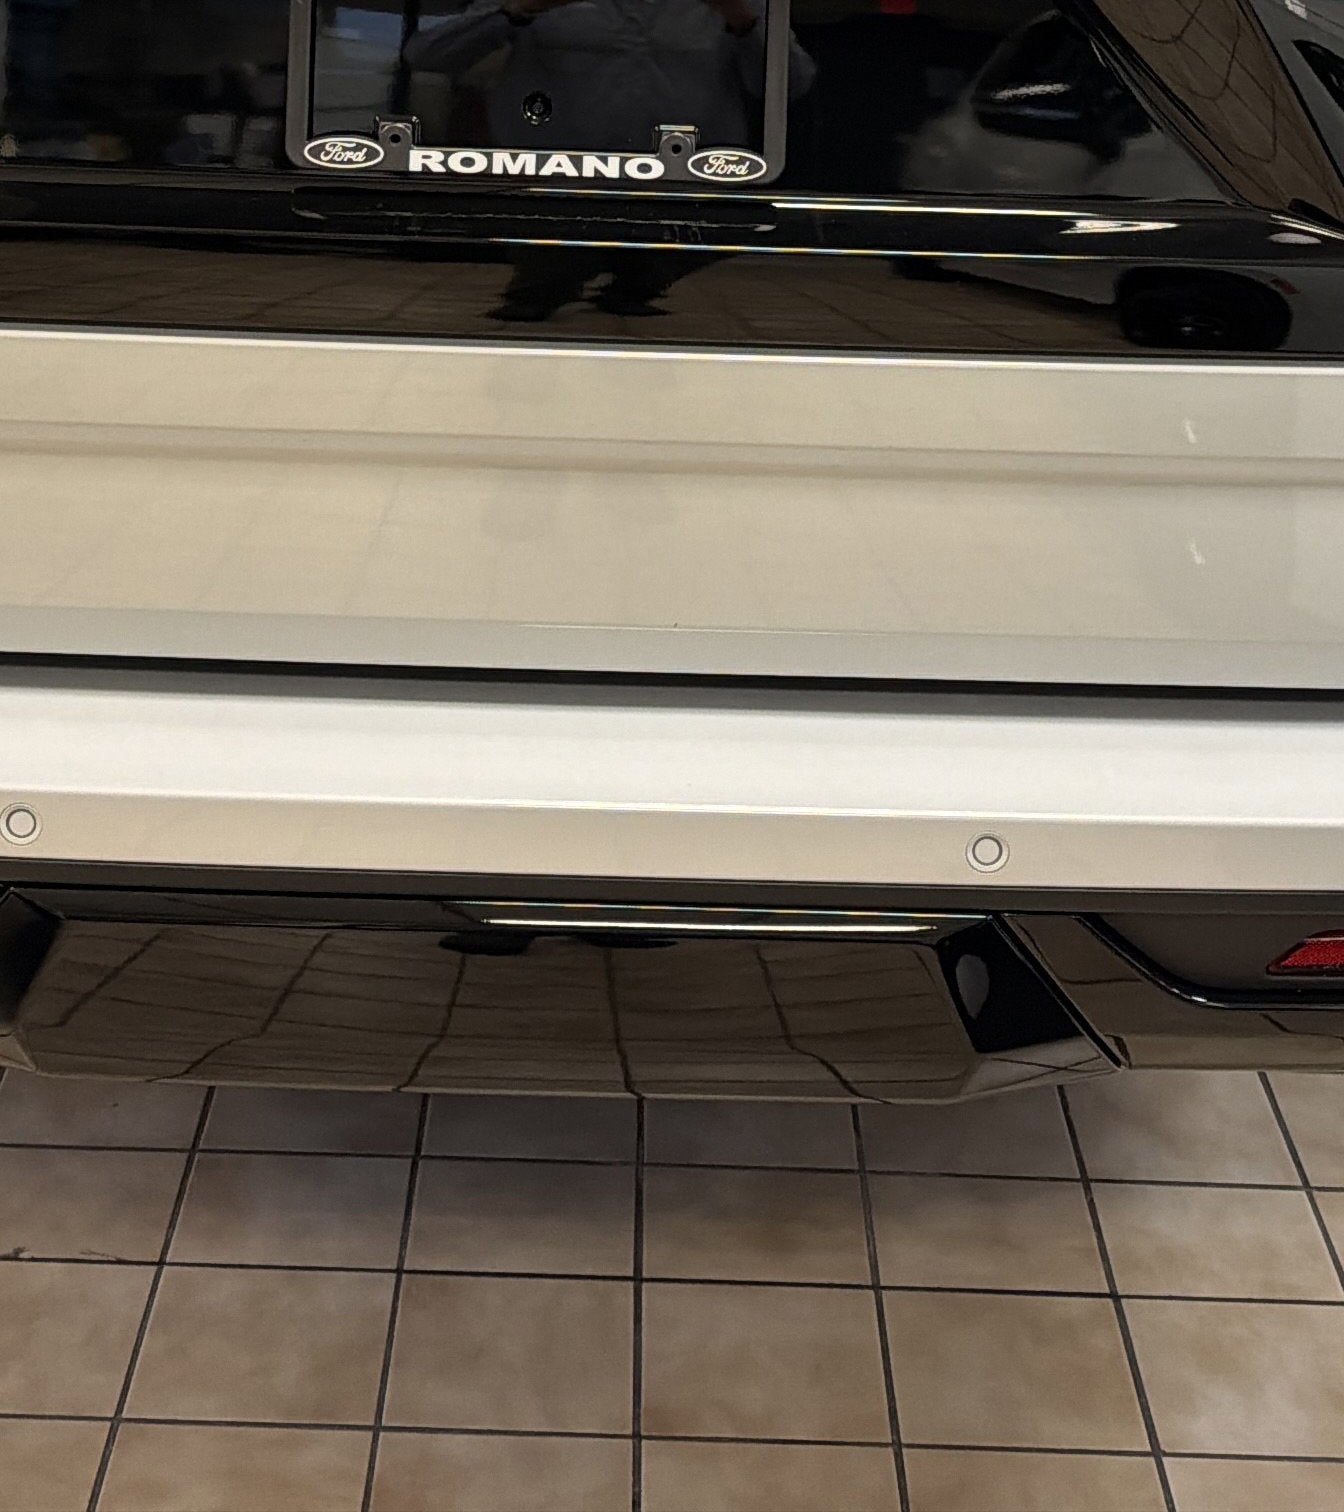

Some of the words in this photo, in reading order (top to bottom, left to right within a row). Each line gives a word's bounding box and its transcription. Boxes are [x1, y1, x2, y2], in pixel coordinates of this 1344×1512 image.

[319, 137, 368, 164] Ford
[408, 149, 666, 180] ROMANO
[702, 154, 751, 178] Ford
